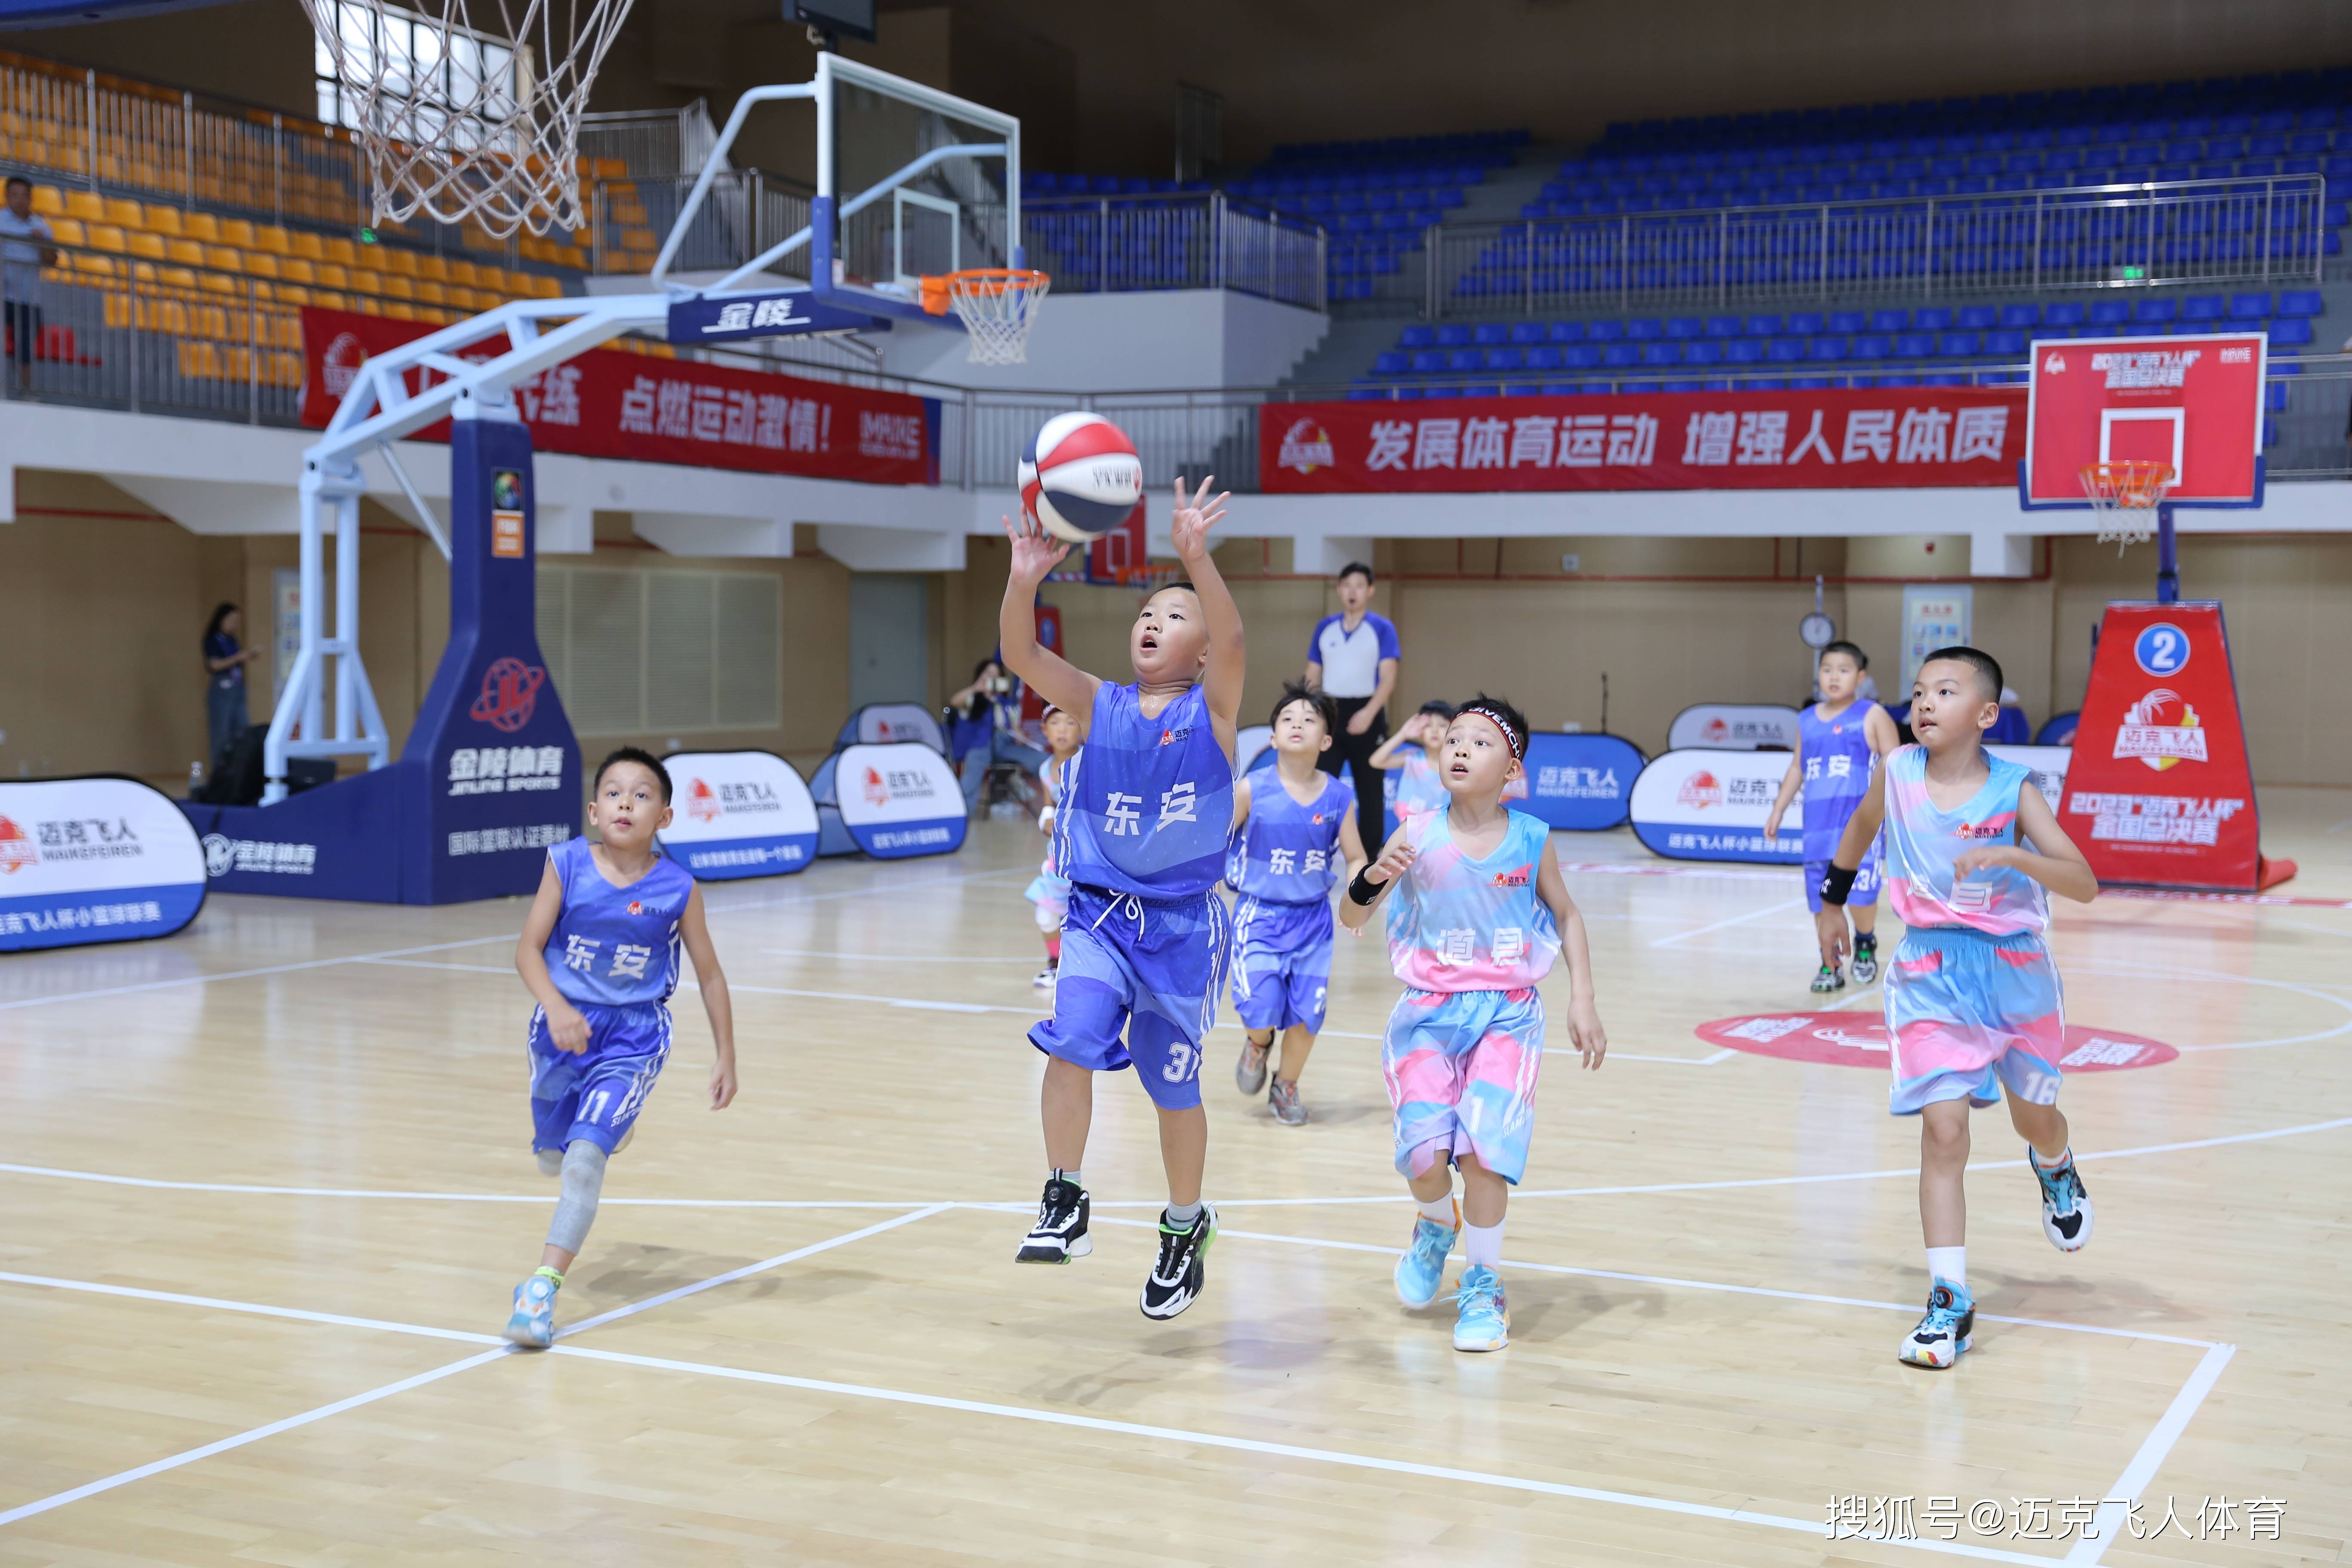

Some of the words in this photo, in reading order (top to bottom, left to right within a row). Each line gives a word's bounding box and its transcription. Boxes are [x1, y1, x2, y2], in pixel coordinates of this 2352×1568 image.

[701, 298, 811, 334] 金陵
[1365, 413, 1659, 471] 发展体育运动
[1681, 405, 2009, 466] 增强人民体质
[2151, 631, 2176, 668] 2
[2125, 729, 2200, 747] 迈克飞人
[1537, 766, 1619, 788] 迈克飞人
[1806, 754, 1851, 781] 东安
[1104, 781, 1197, 836] 东安
[37, 818, 138, 846] 迈克飞人
[2091, 814, 2220, 846] 全国总决赛
[1270, 848, 1326, 875] 东安
[563, 934, 651, 980] 东安
[1436, 927, 1525, 966] 道县
[576, 1089, 611, 1125] 11
[1470, 1097, 1484, 1135] 1
